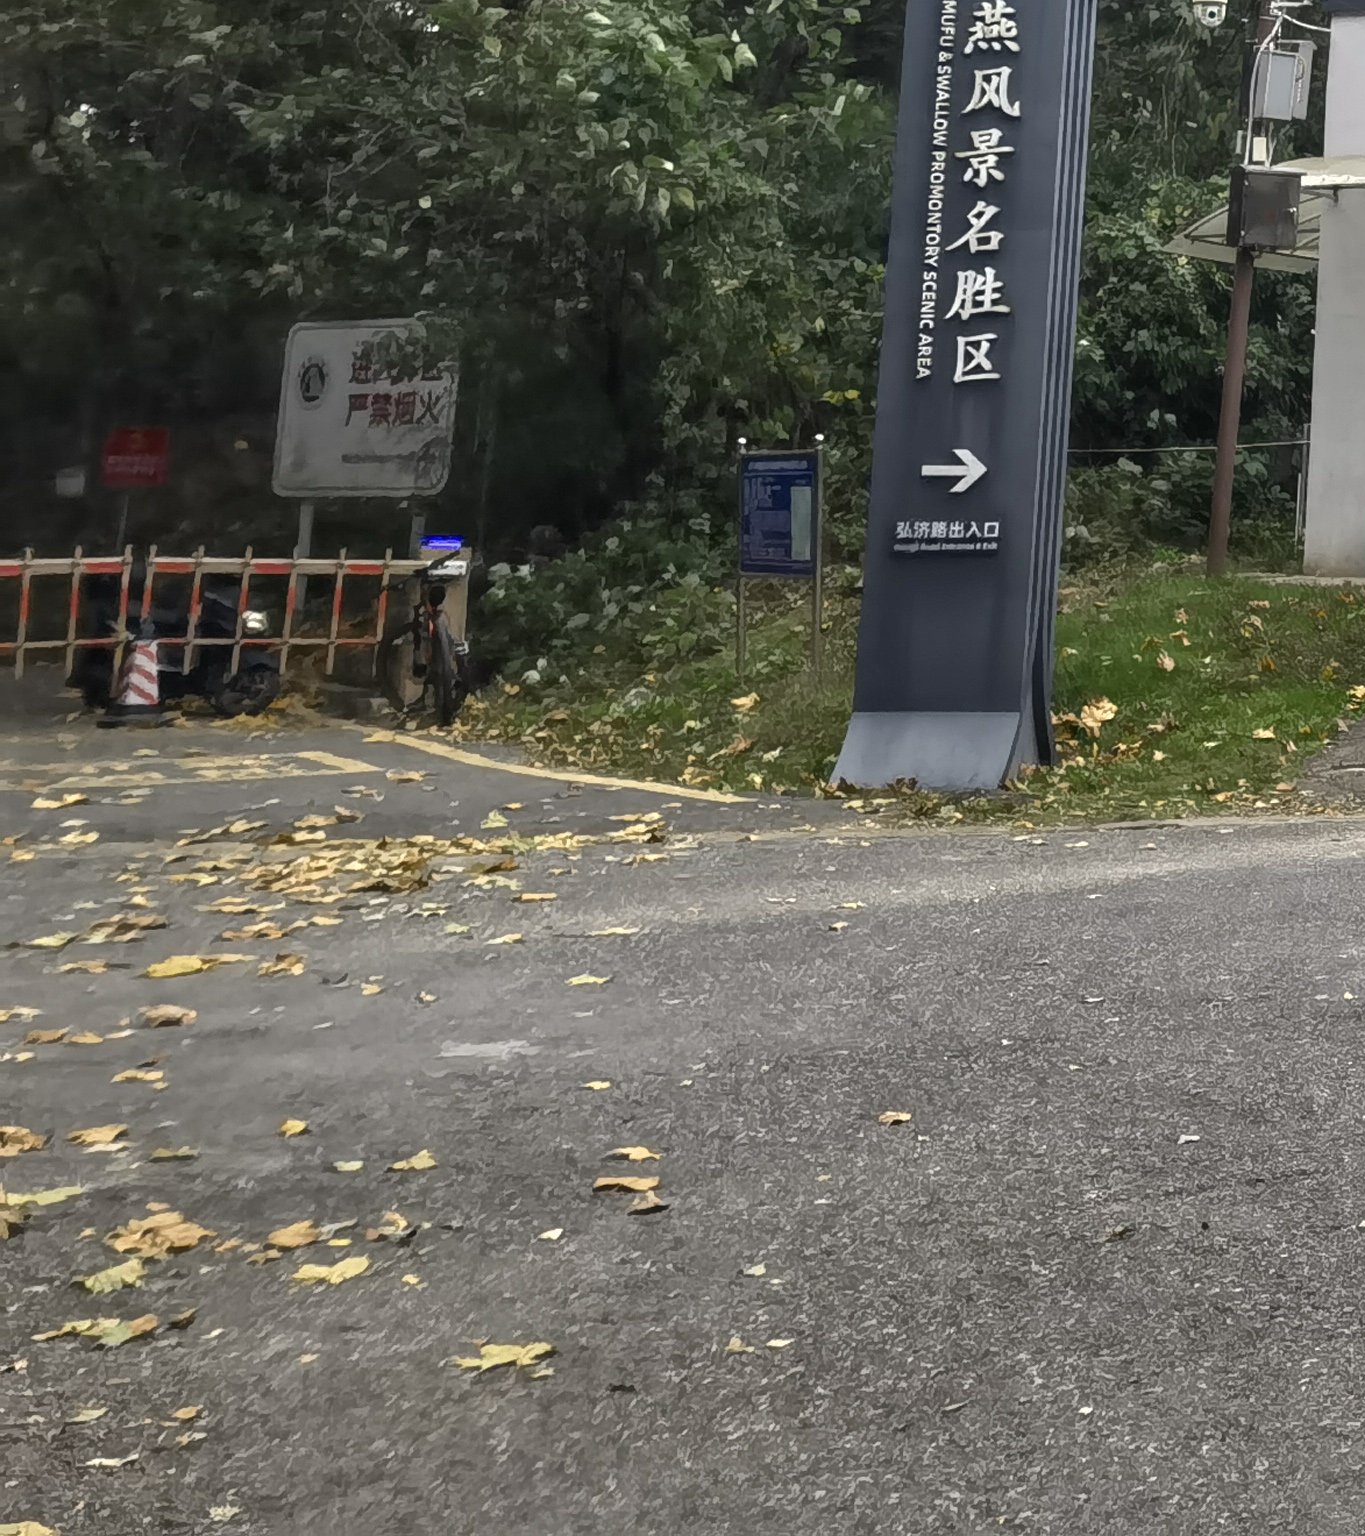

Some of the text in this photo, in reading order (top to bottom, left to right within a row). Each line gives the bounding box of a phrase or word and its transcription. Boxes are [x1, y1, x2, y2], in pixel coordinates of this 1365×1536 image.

[939, 0, 957, 47] MUFU
[938, 51, 953, 62] &
[932, 65, 952, 147] SWALLOW
[923, 151, 947, 267] PROMONTORY
[919, 271, 938, 329] SCENIC
[915, 333, 934, 380] AREA
[345, 390, 442, 427] 严禁烟火
